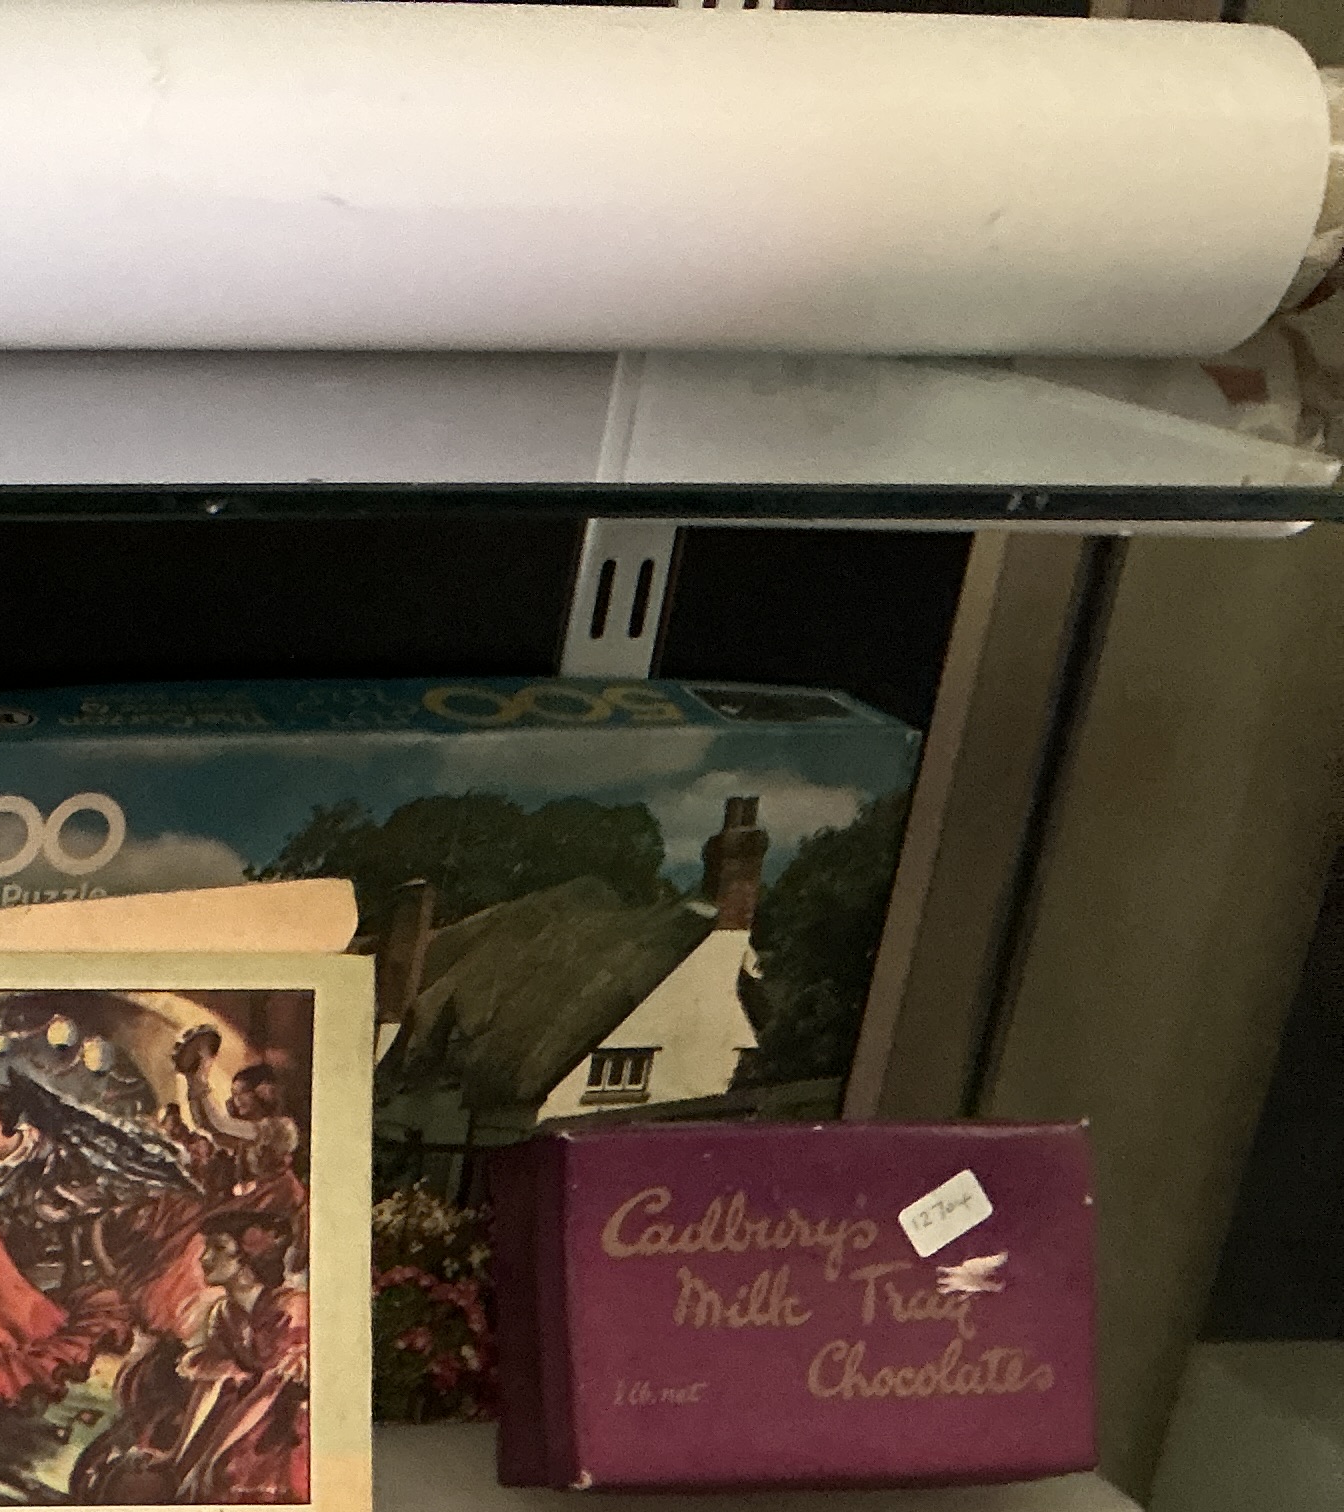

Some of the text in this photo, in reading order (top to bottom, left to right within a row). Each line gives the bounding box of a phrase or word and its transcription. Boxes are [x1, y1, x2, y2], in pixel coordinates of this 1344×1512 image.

[2, 880, 108, 908] Puzzle
[601, 1186, 880, 1281] Cadbury's
[673, 1261, 979, 1341] Milk Tray
[808, 1338, 1055, 1400] Chocolates
